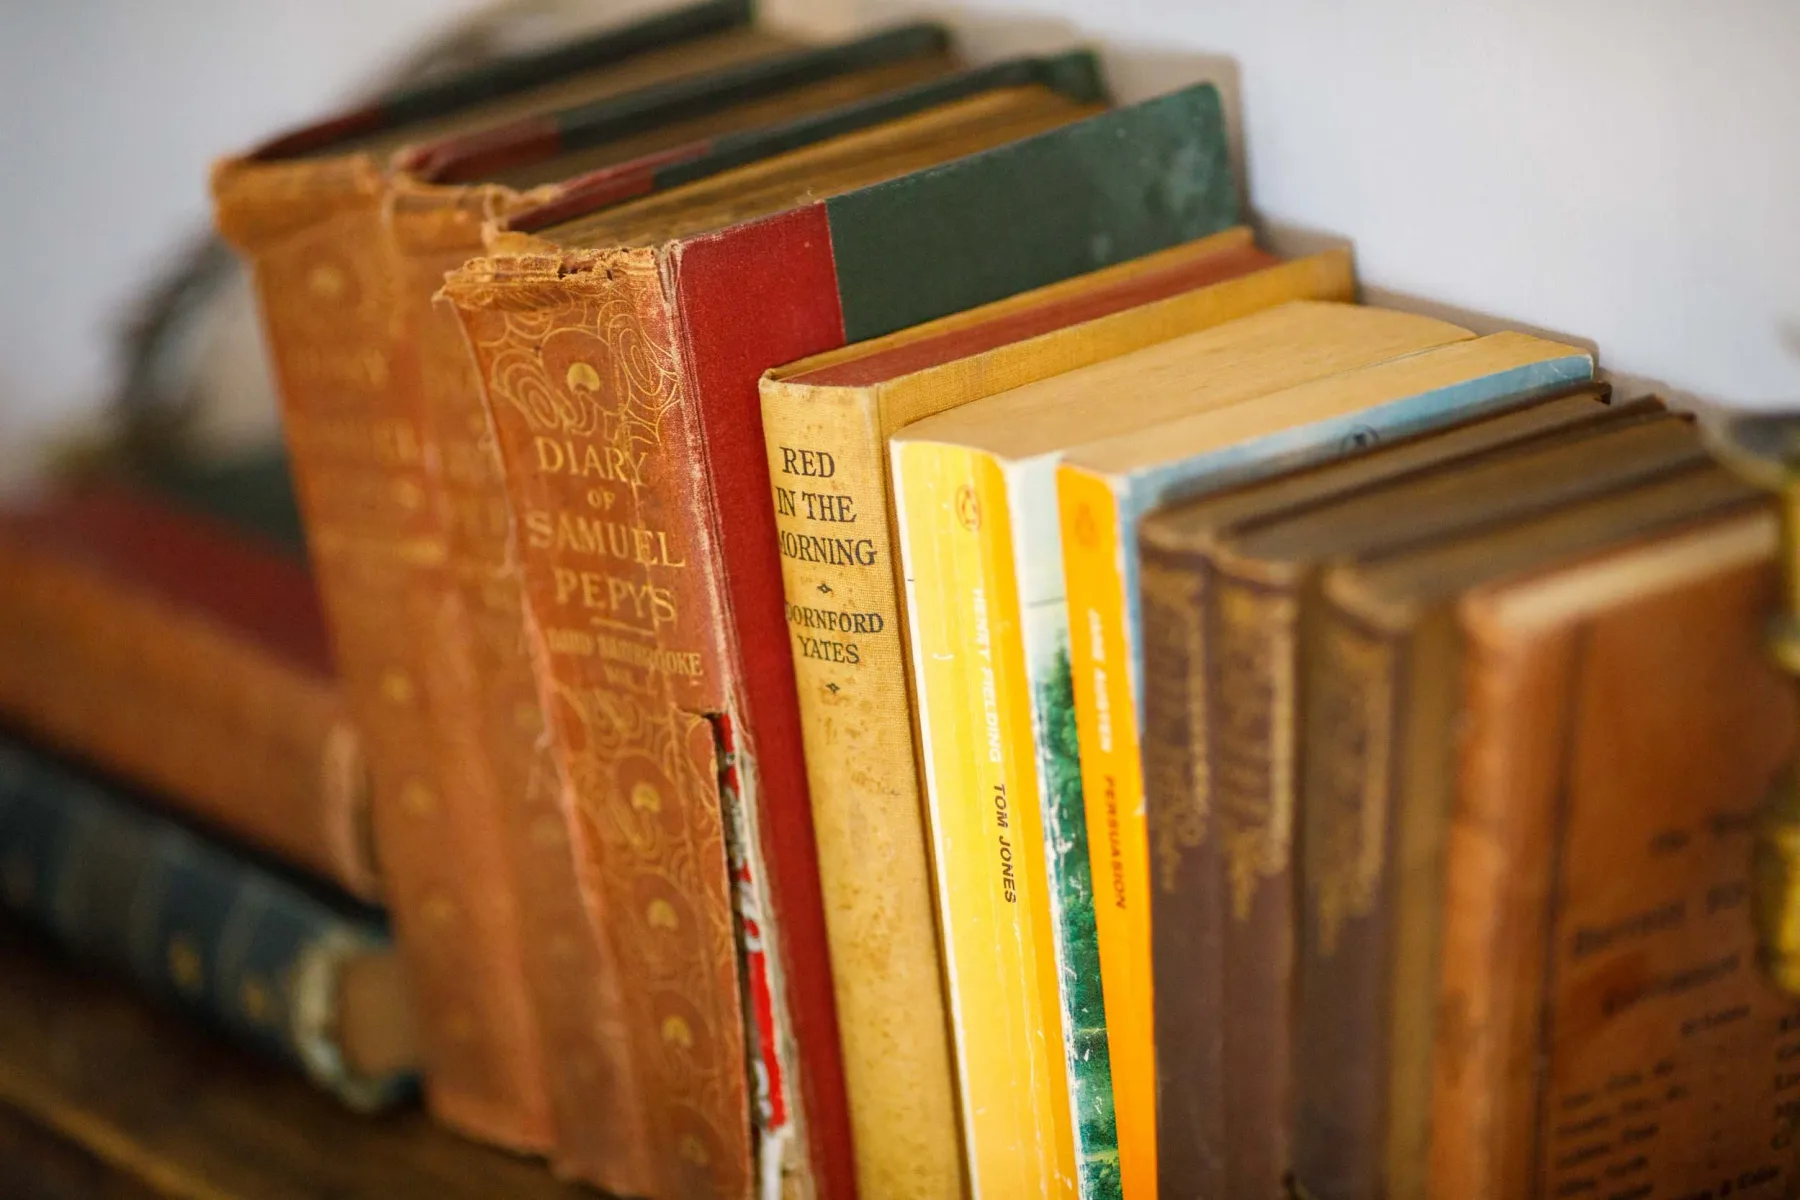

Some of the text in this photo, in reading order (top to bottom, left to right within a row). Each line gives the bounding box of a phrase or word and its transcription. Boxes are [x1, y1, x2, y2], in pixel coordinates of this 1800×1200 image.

[534, 435, 649, 487] DIARY
[780, 446, 836, 478] RED
[587, 489, 616, 510] OF
[776, 486, 858, 524] IN THE
[525, 510, 686, 568] SAMUEL
[554, 567, 676, 622] PEPYS
[797, 635, 861, 664] YATES
[981, 667, 1002, 763] FIELDING
[992, 783, 1017, 904] TOM JONES
[1104, 776, 1128, 910] PERSUASION
